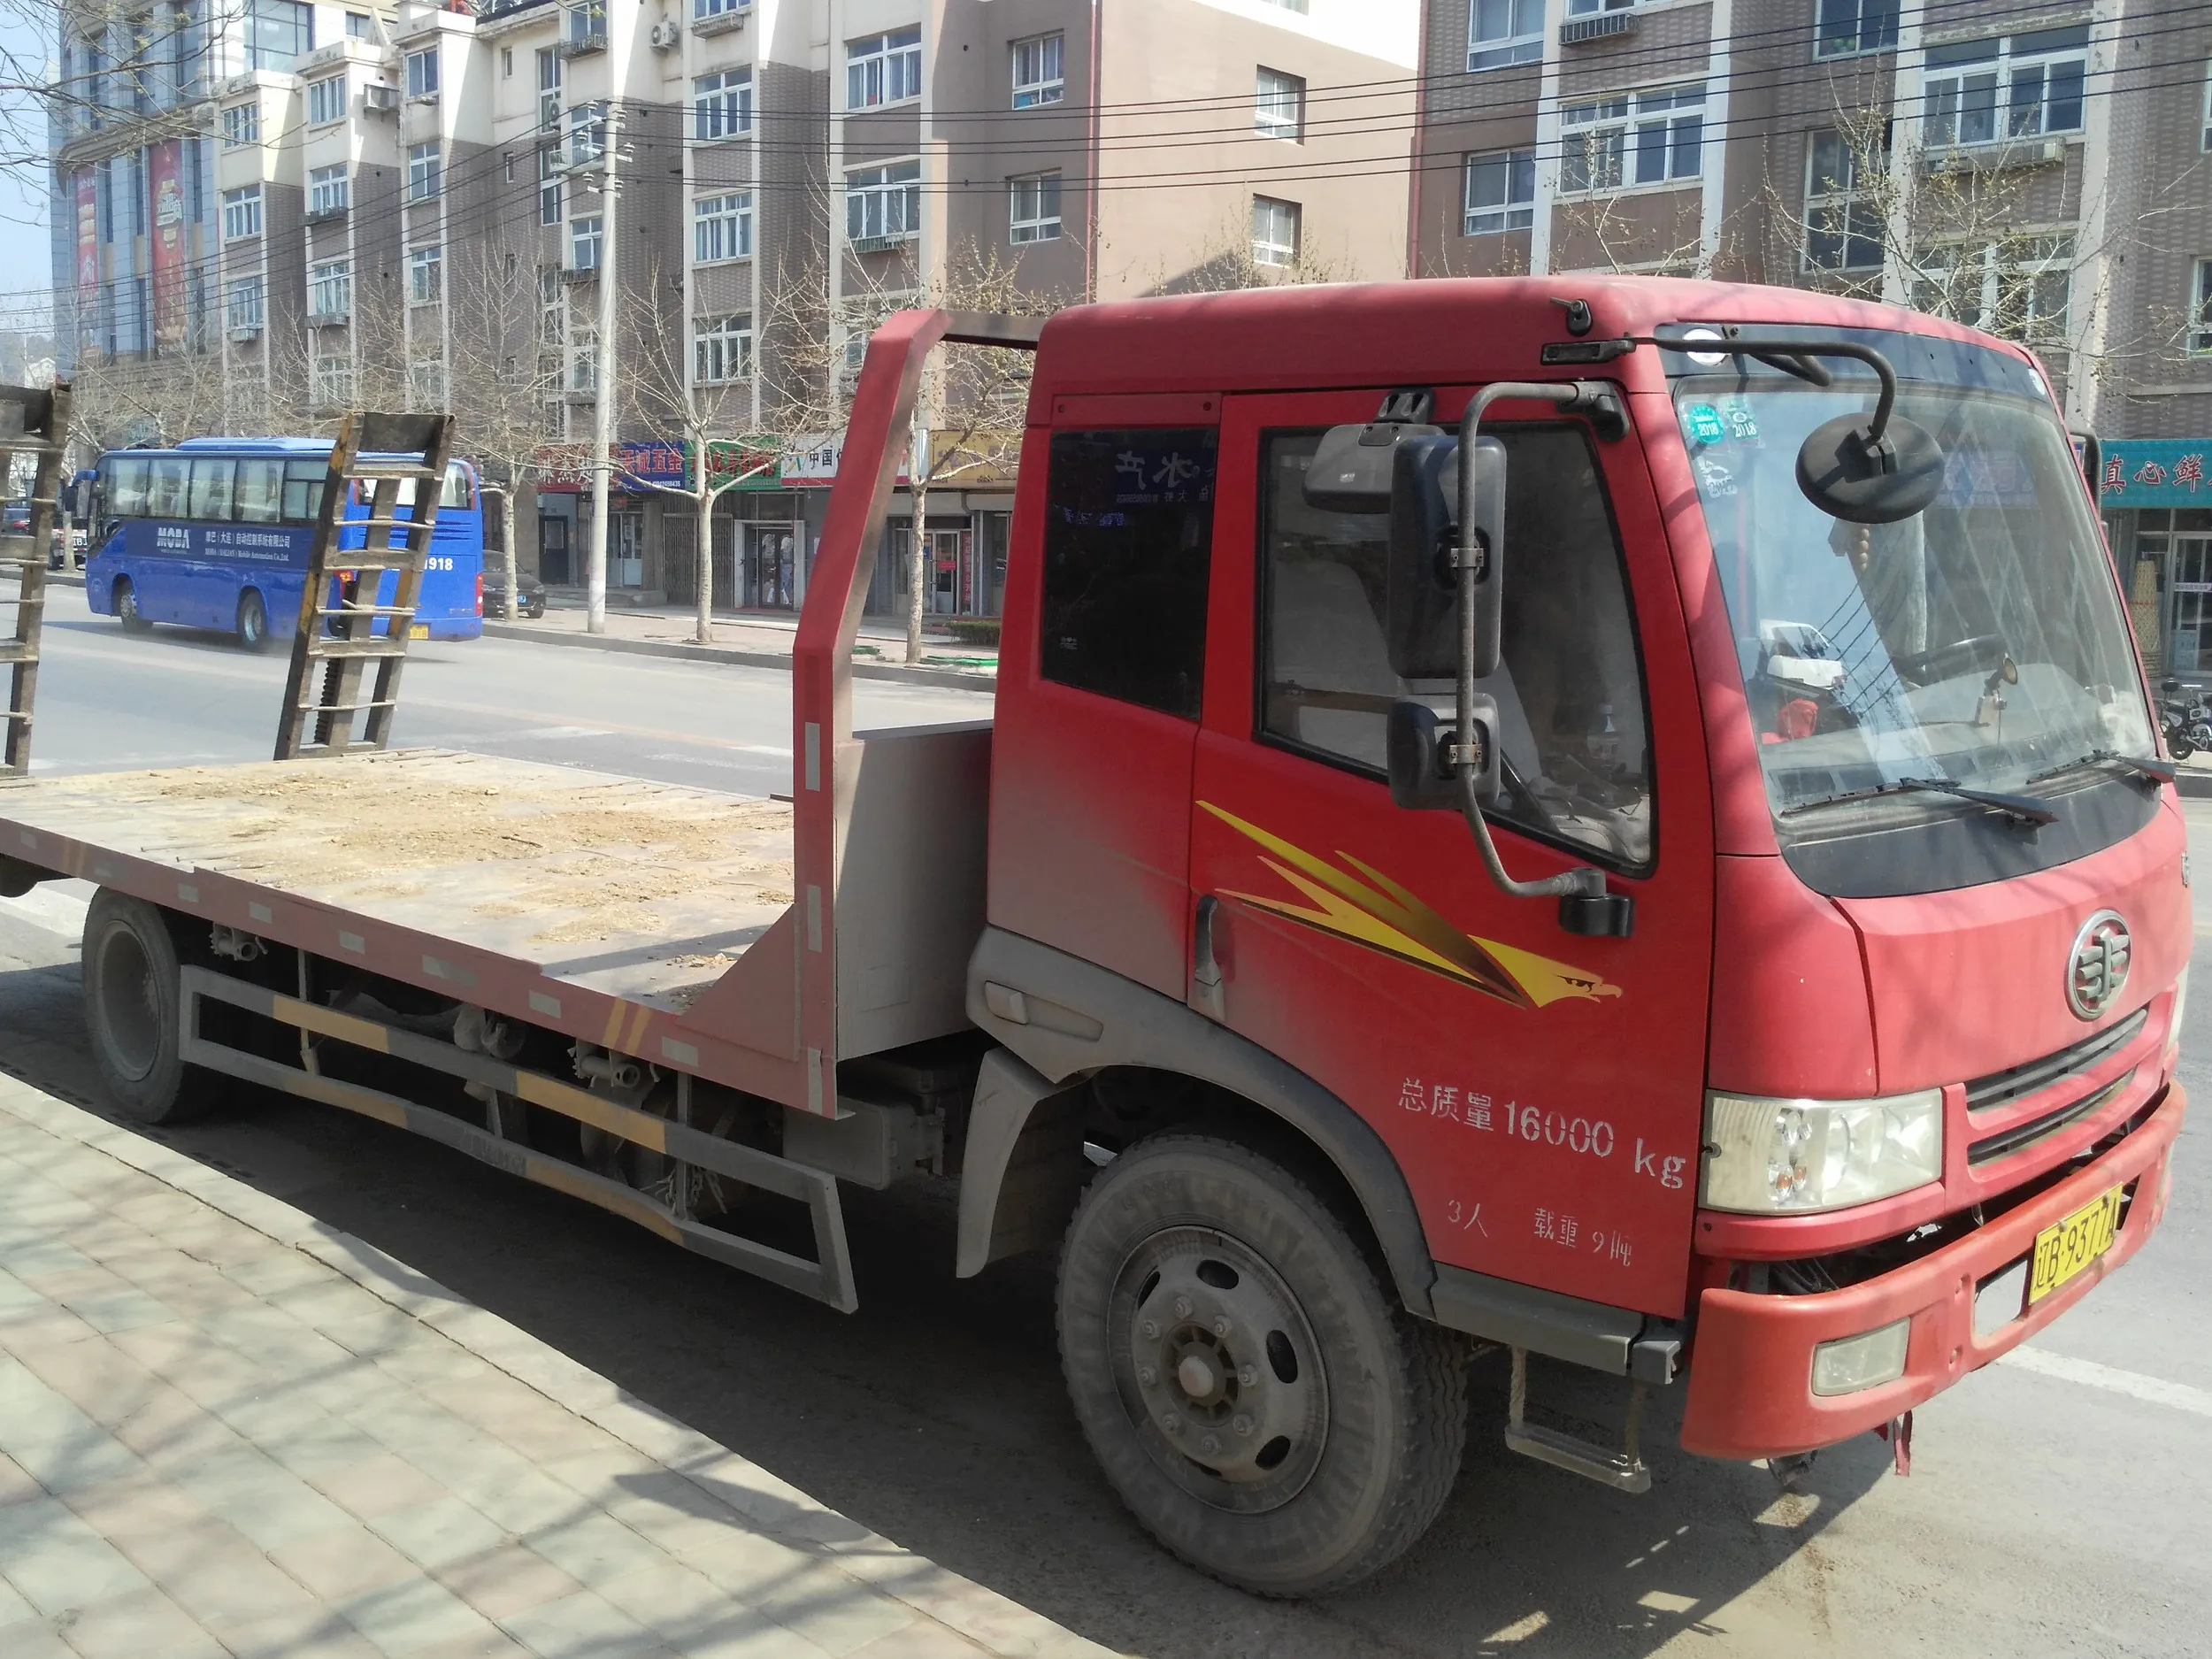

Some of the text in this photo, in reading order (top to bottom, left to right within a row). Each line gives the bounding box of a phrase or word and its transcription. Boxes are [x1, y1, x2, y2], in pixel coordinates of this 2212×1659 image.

[1697, 422, 1719, 436] 2018
[1732, 422, 1757, 438] 2018
[2101, 453, 2212, 495] 真心鲜
[157, 527, 190, 549] MOBA
[1399, 1077, 1686, 1189] 总质量 16000 kg
